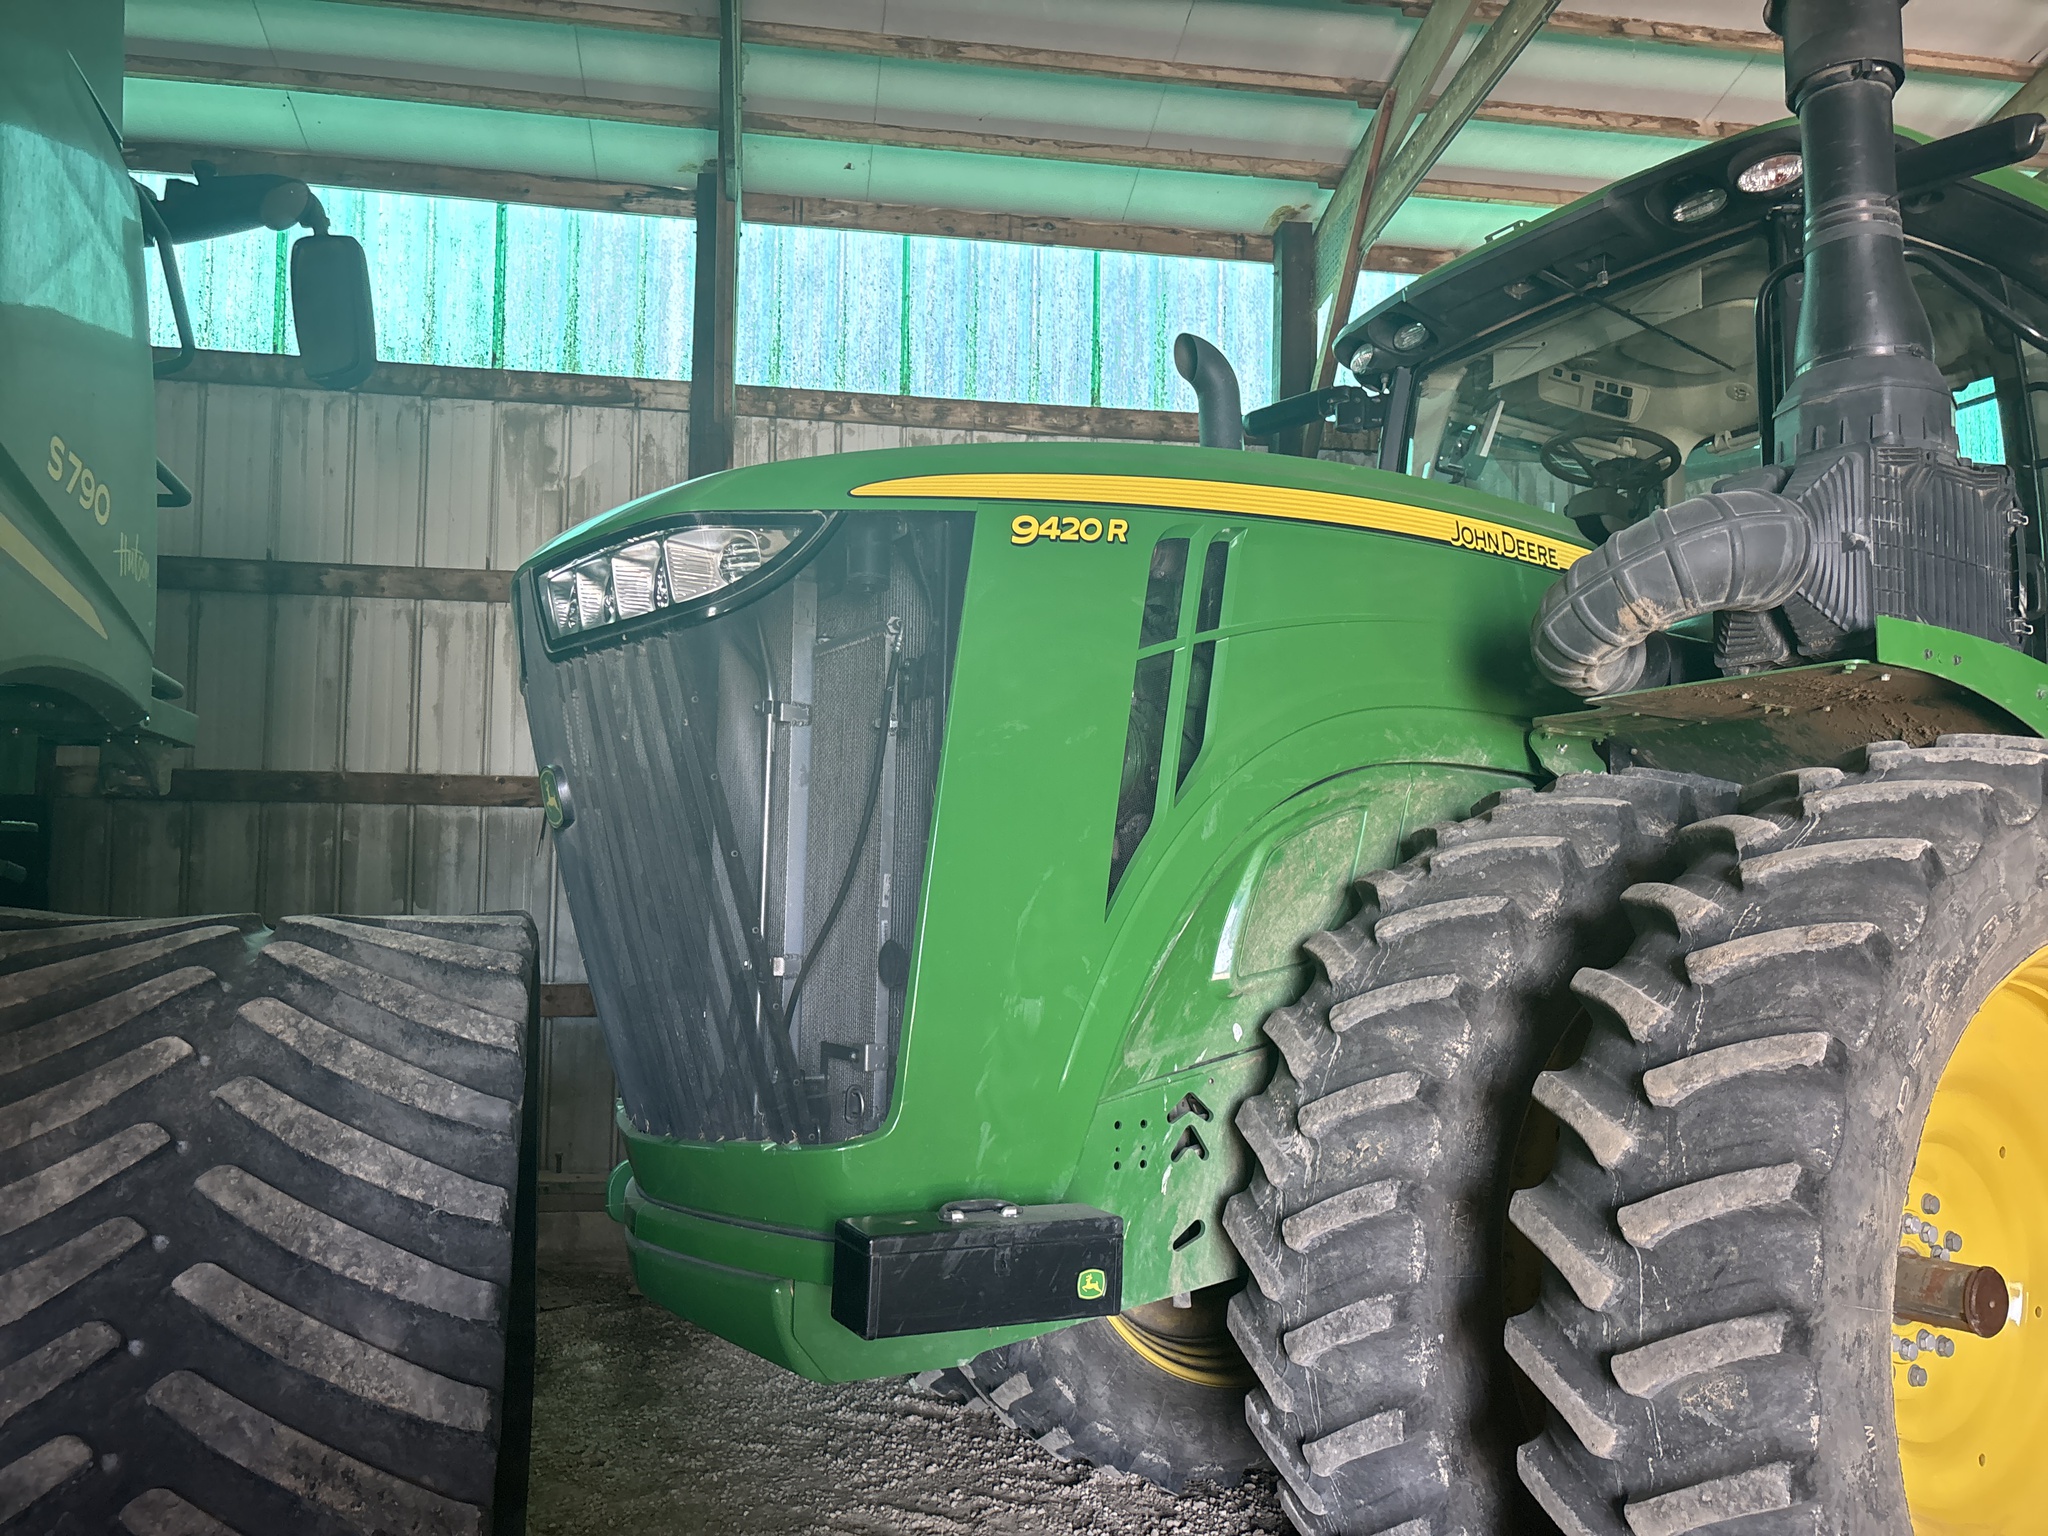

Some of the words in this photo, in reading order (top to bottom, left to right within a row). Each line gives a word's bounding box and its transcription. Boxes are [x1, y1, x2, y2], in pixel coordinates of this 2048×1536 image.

[47, 435, 111, 526] S790
[1450, 519, 1500, 551] JOHN
[1501, 530, 1559, 566] DEERE
